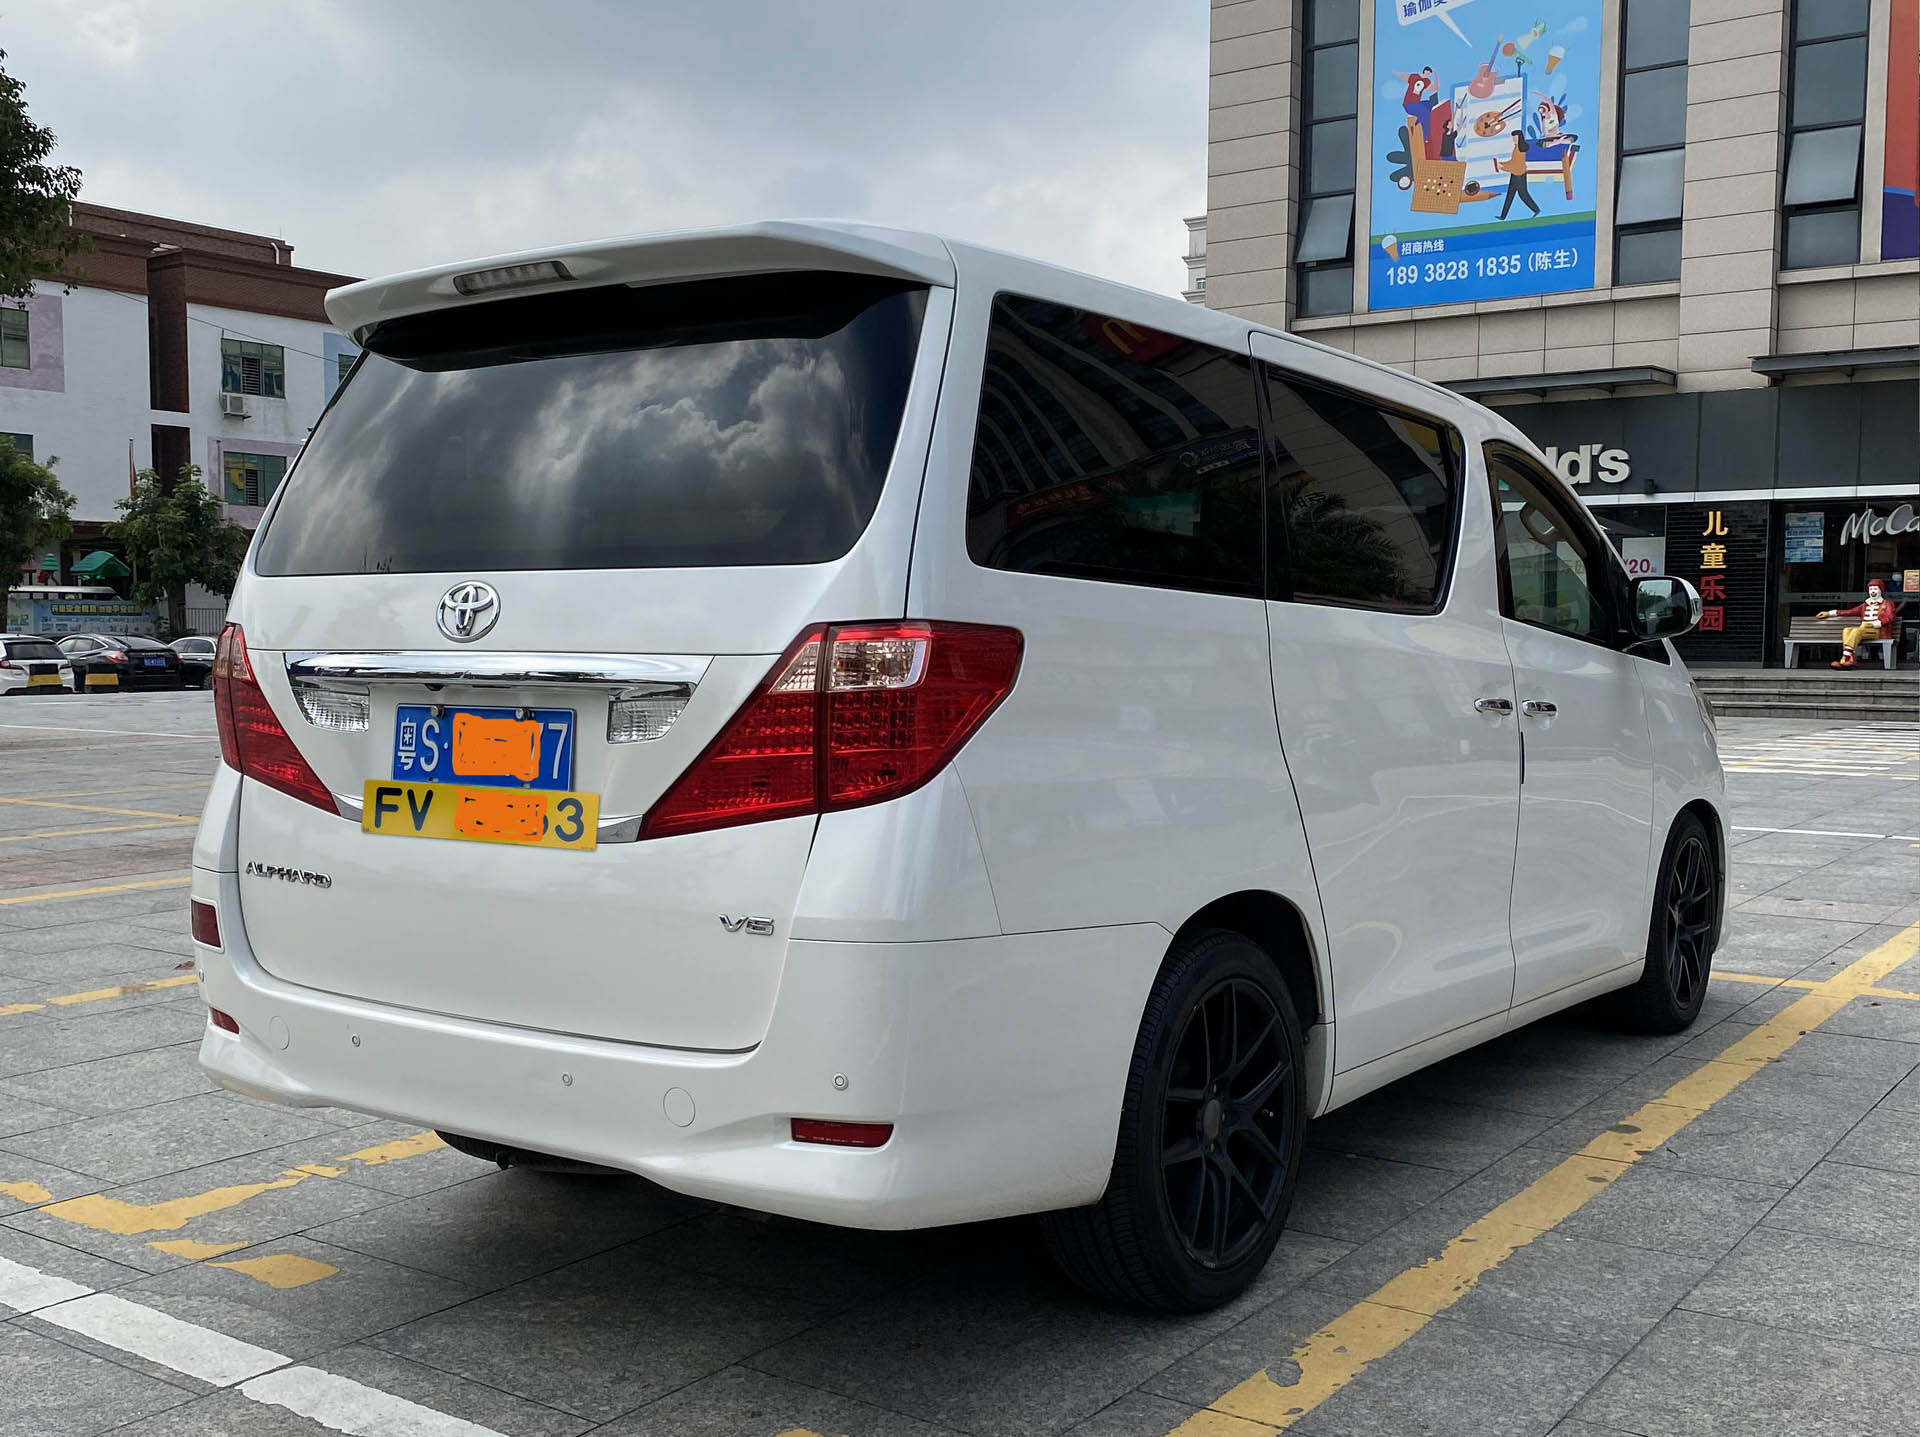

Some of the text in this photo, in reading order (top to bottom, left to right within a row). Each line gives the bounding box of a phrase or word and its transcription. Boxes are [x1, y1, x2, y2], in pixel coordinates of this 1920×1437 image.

[1401, 240, 1445, 255] 招商热线
[1386, 265, 1418, 286] 189
[1424, 260, 1469, 283] 3828
[1476, 254, 1521, 278] 1835
[1699, 511, 1728, 631] 儿童乐园
[374, 786, 434, 831] FV
[245, 861, 332, 888] ALPHARD
[718, 914, 774, 936] V6
